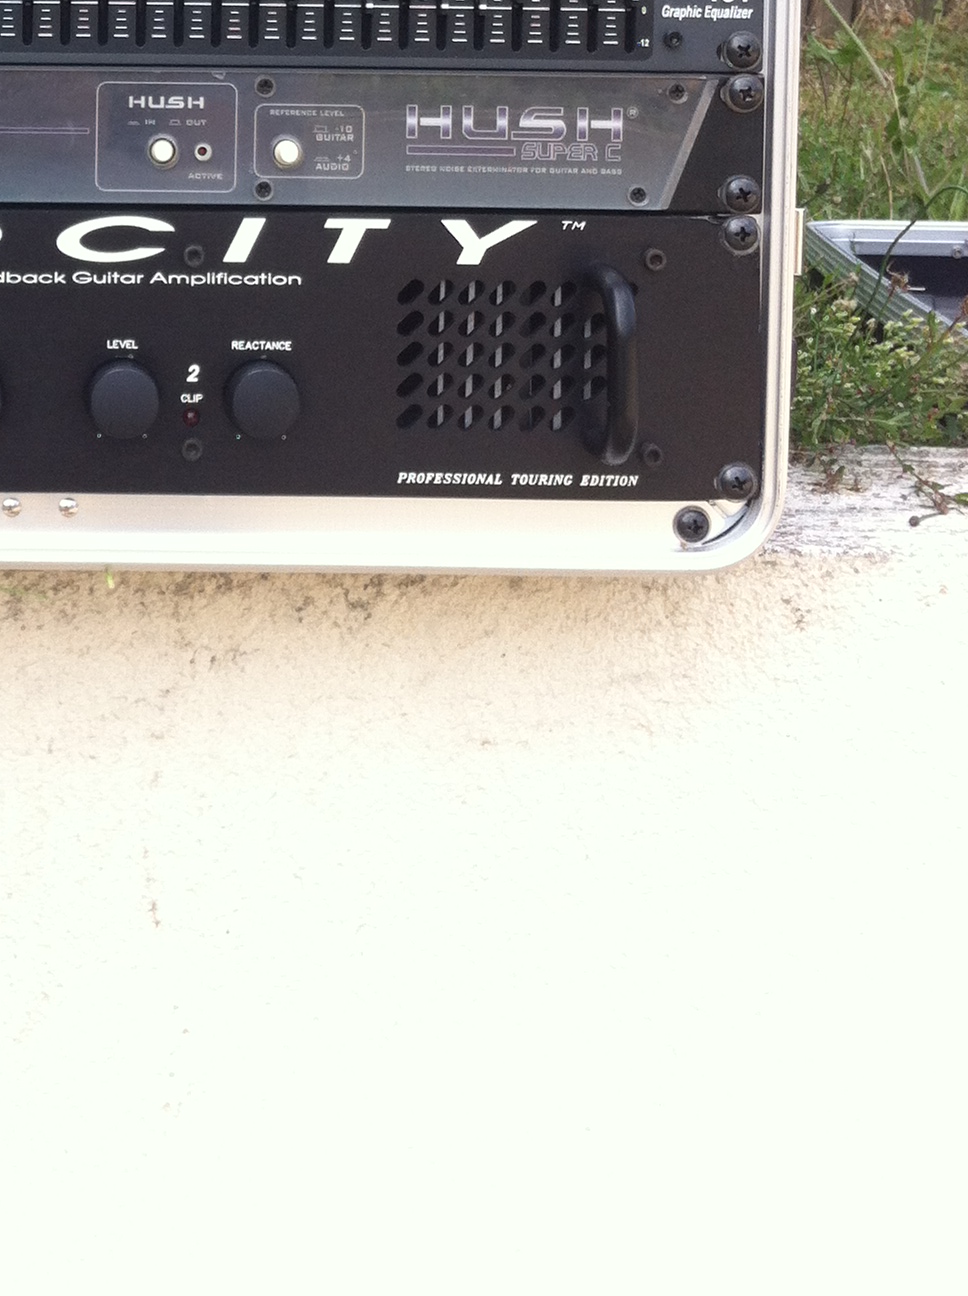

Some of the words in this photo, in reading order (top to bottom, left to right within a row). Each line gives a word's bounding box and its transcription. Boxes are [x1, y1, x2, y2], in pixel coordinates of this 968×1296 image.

[662, 5, 702, 20] Graphic
[704, 6, 753, 21] Equalizer
[128, 95, 205, 109] HUSH
[406, 104, 624, 142] HUSH
[315, 133, 354, 142] GUITAR
[520, 142, 598, 162] SUPER
[605, 143, 621, 162] C
[315, 163, 350, 171] AUDIO
[405, 165, 436, 173] STEREO
[439, 165, 465, 173] NOISE
[530, 166, 546, 174] FOR
[549, 166, 578, 174] GUITAR
[580, 167, 598, 175] AND
[72, 270, 144, 286] Guitar
[149, 271, 302, 288] Amplification
[107, 339, 138, 350] LEVEL
[231, 340, 292, 351] REACTANCE
[186, 364, 200, 382] 2
[181, 394, 203, 403] CLIP
[397, 472, 502, 485] PROFESSIONAL
[511, 474, 573, 486] TOURING
[580, 475, 639, 487] EDITION
